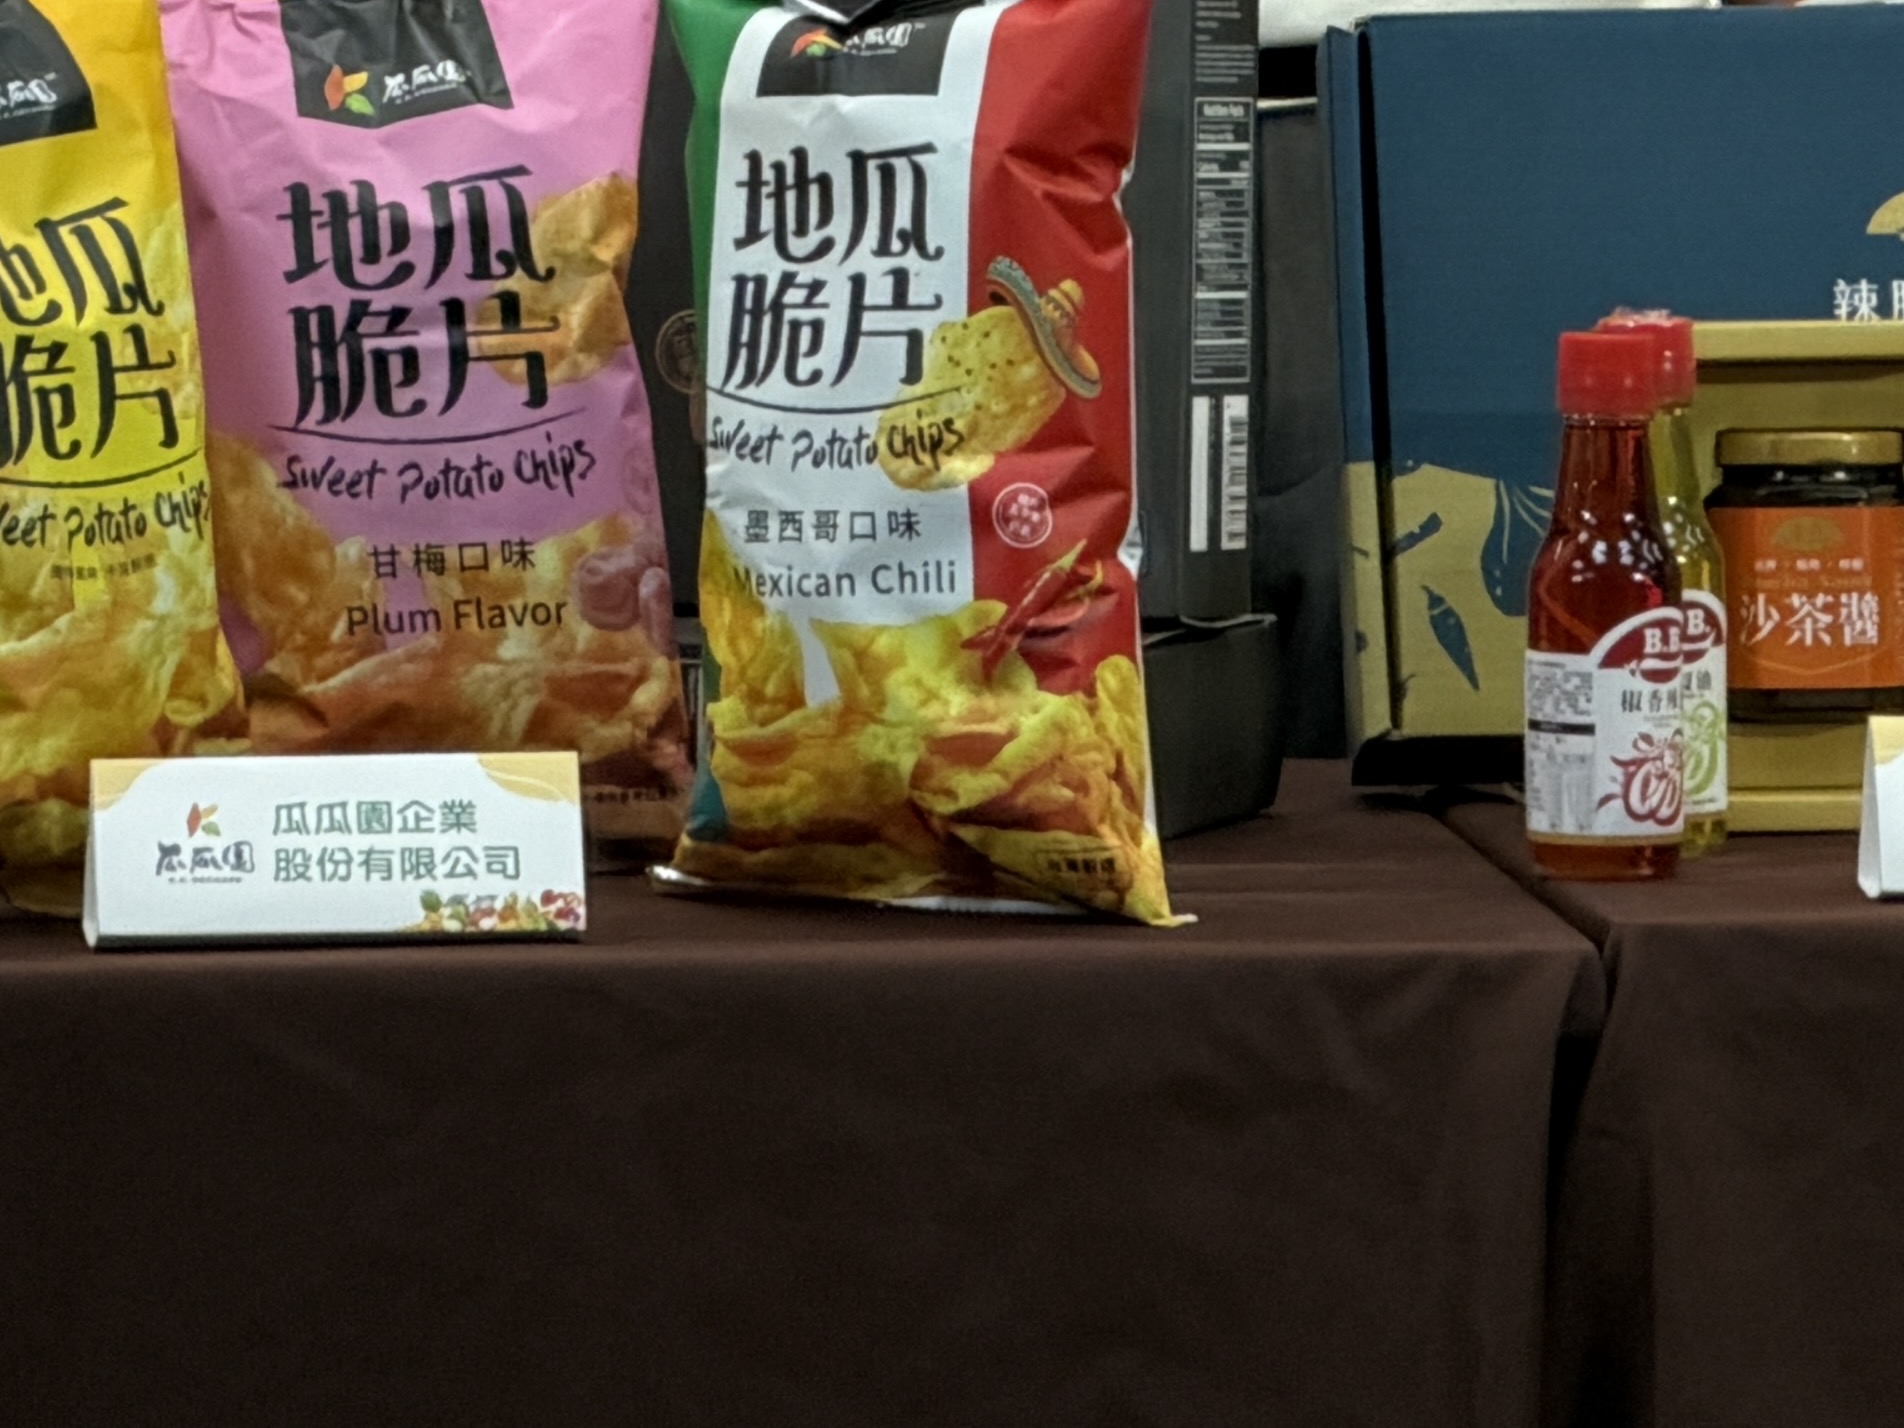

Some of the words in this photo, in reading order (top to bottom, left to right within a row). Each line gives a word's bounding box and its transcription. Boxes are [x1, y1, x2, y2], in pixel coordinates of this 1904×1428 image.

[275, 164, 555, 292] 地瓜
[732, 141, 945, 267] 地瓜
[720, 266, 945, 391] 脆片
[286, 290, 561, 430] 脆片
[707, 416, 779, 466] Sweet
[790, 429, 878, 471] Potato
[886, 407, 966, 471] Chips
[276, 453, 386, 500] Sweet
[397, 451, 505, 504] Potato
[512, 432, 597, 500] Chips
[63, 497, 147, 548] Potato
[743, 509, 923, 544] 墨西哥口味
[366, 537, 537, 579] 甘梅口味
[732, 564, 857, 599] Mexican
[876, 559, 958, 596] Chili
[346, 604, 441, 637] Plum
[452, 599, 569, 632] Flavor
[1740, 592, 1880, 646] 沙茶醬
[271, 799, 478, 836] 瓜瓜園企業
[272, 845, 522, 882] 股份有限公司
